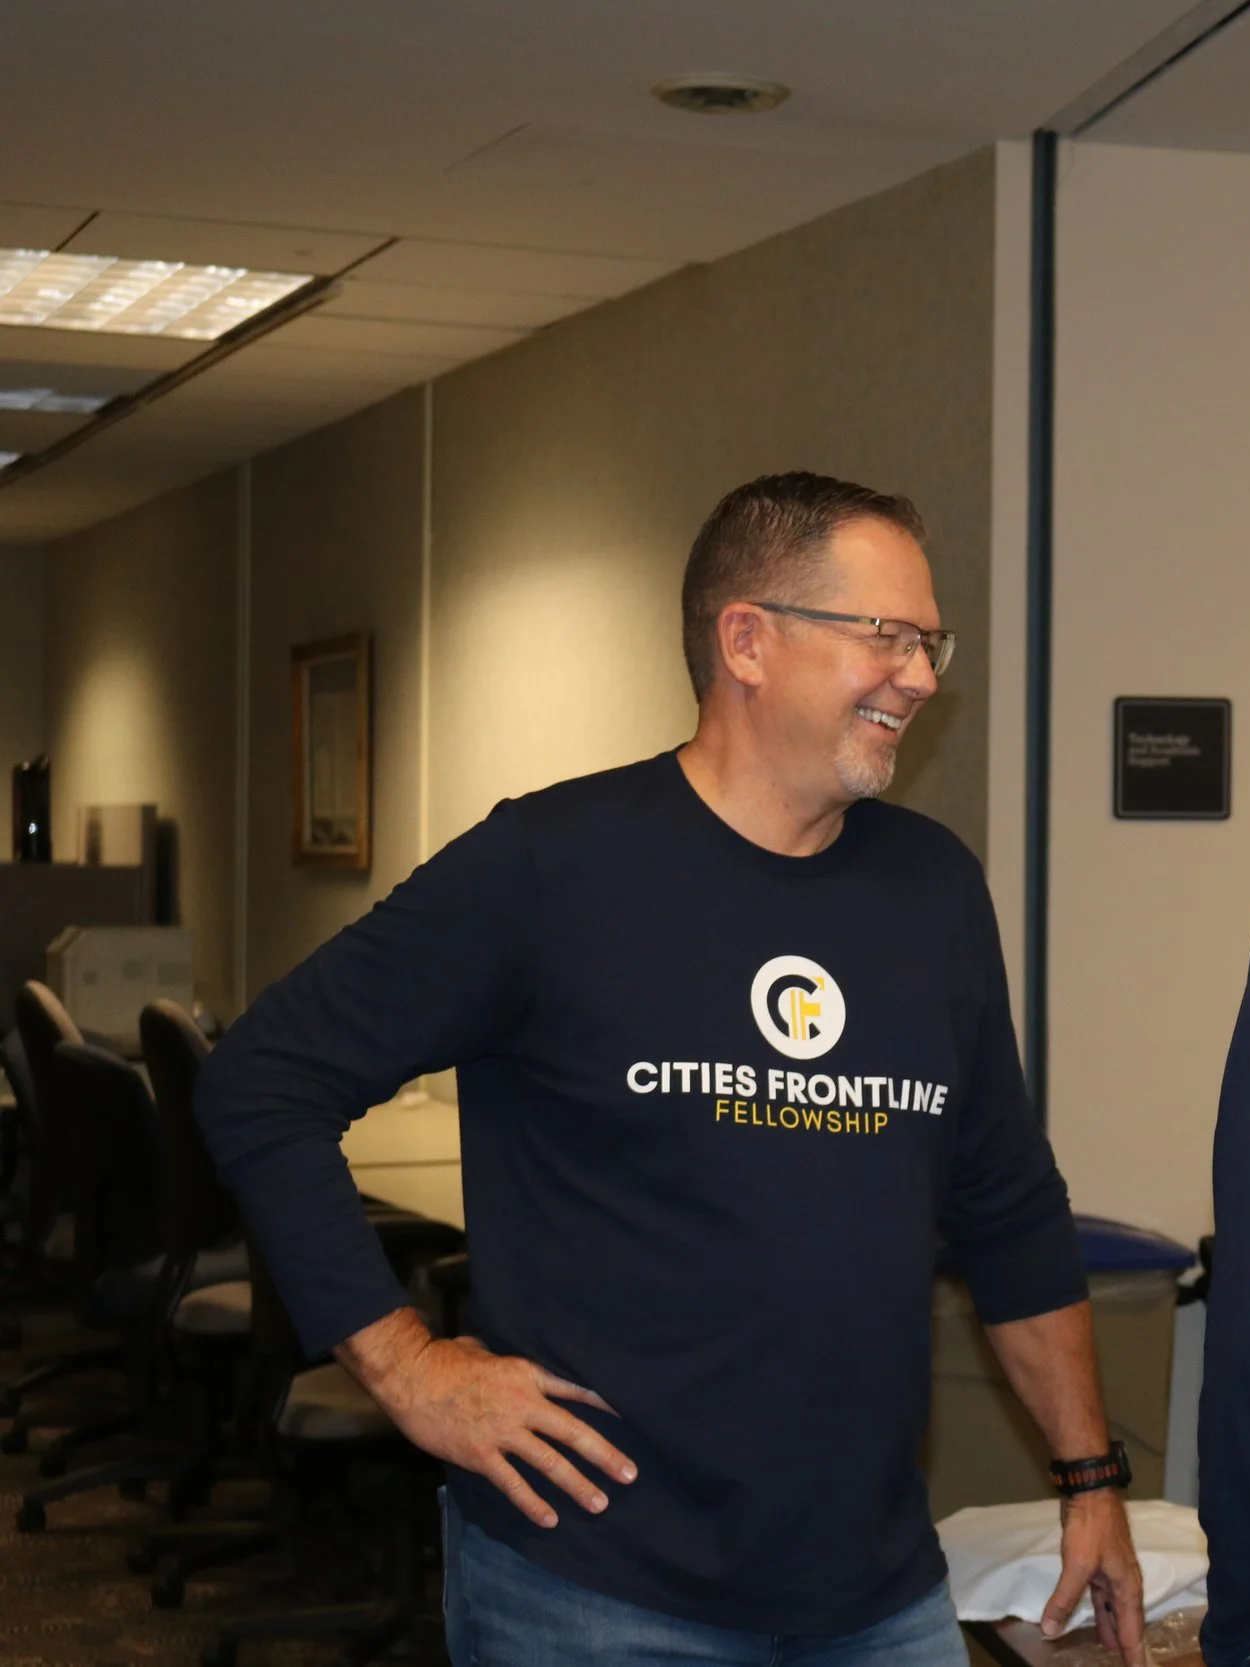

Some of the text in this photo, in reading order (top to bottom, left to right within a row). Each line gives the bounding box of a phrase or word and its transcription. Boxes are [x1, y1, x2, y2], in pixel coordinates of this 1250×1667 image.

[626, 1061, 949, 1116] CITIES FRONTLINE
[715, 1099, 889, 1135] FELLOWSHIP
